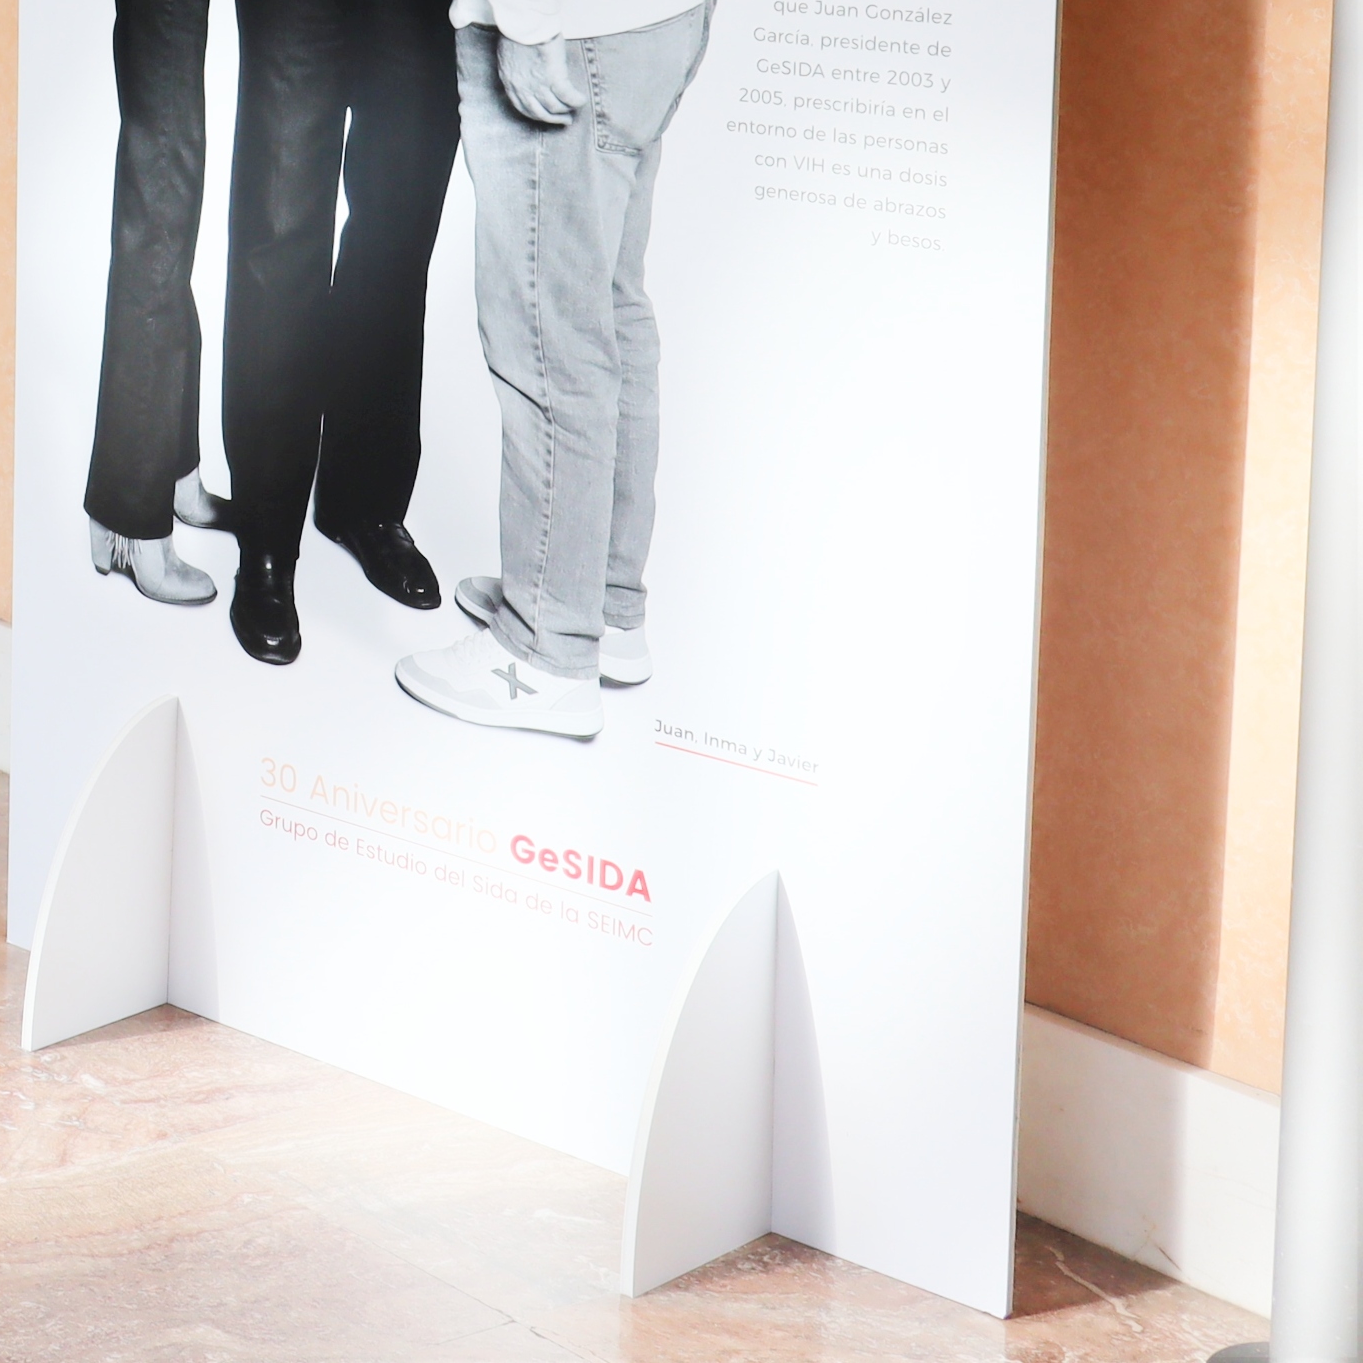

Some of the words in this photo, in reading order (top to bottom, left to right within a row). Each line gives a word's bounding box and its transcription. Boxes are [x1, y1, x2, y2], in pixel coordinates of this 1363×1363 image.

[655, 718, 699, 744] Juan,
[703, 729, 747, 756] Inma
[753, 745, 763, 761] y
[767, 748, 819, 774] Javier
[259, 757, 297, 794] 30
[308, 773, 498, 856] Aniversario
[510, 833, 653, 904] GeSIDA
[259, 808, 319, 842] Grupo
[324, 823, 350, 852] de
[356, 830, 428, 875] Estudio
[434, 860, 466, 889] del
[472, 874, 519, 906] Sida
[525, 889, 555, 916] de
[560, 896, 579, 923] la
[587, 911, 655, 947] SEIMC
